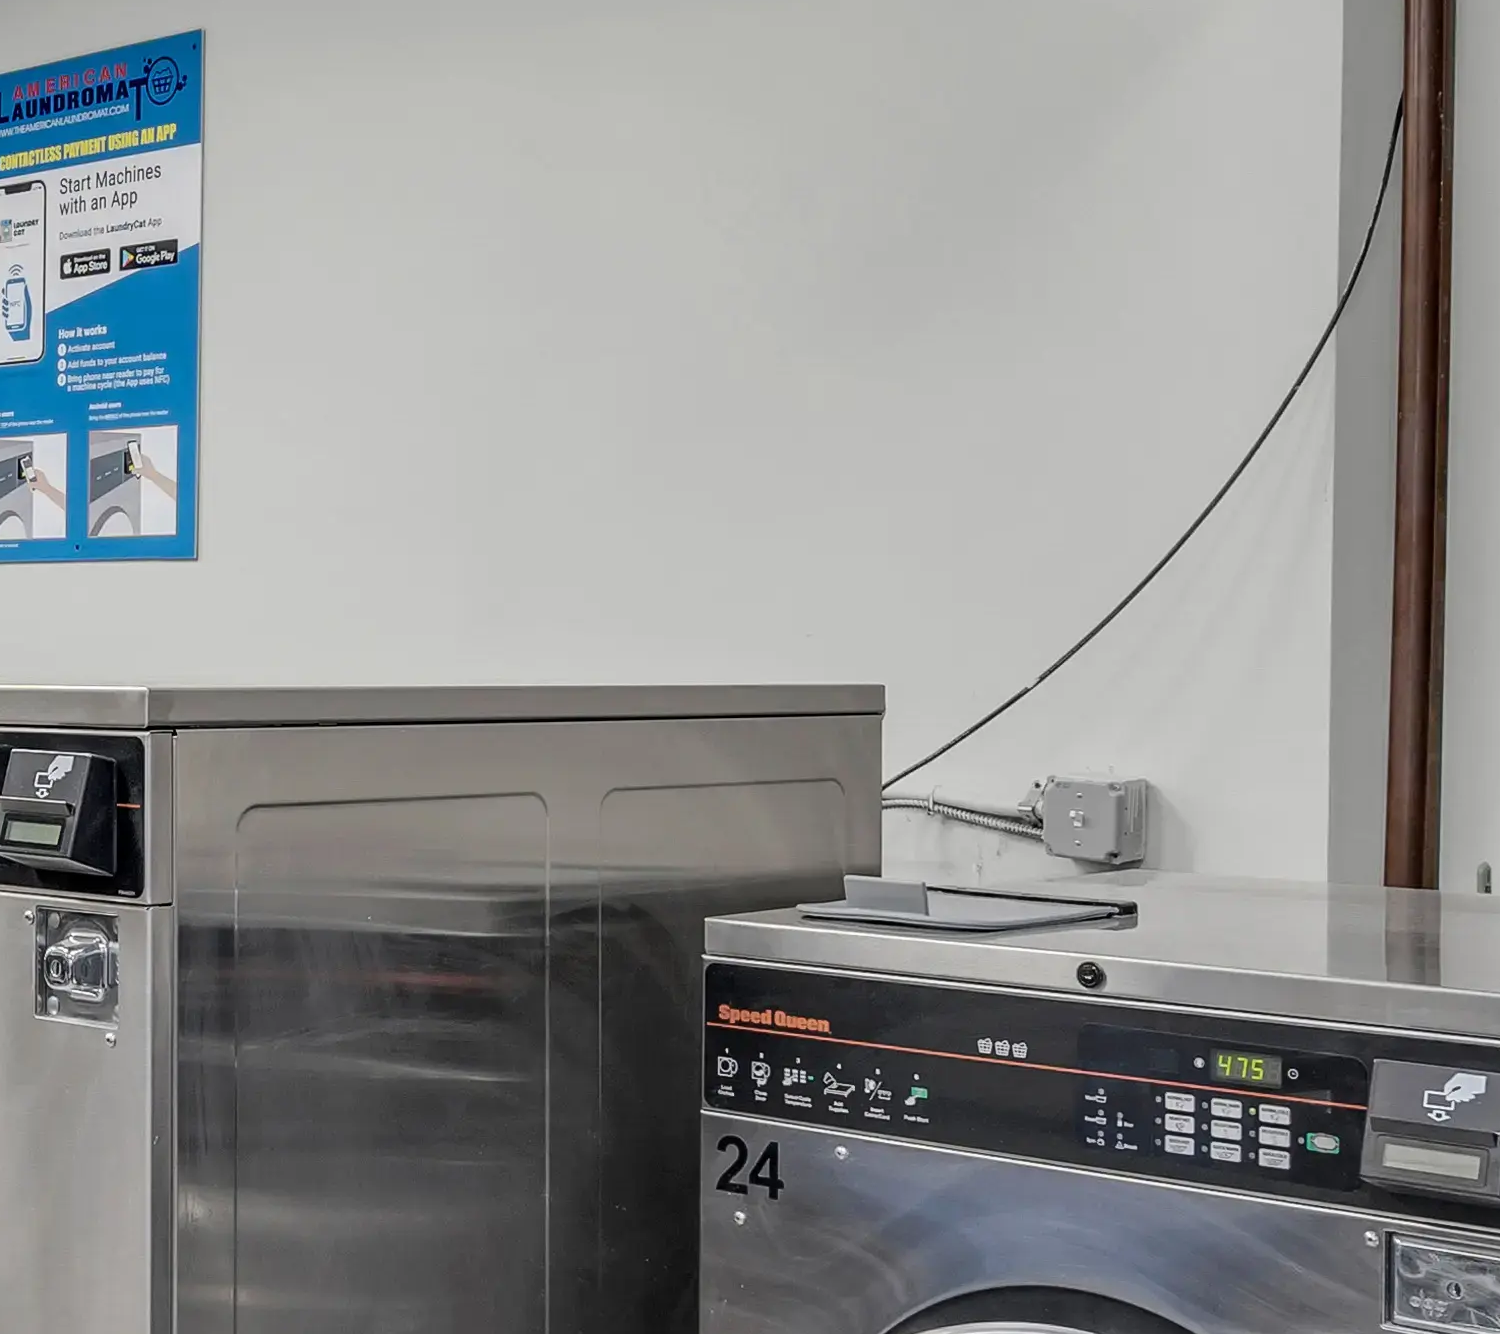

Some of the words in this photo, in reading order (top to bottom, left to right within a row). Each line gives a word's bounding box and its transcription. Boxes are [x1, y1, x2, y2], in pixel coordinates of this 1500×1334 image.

[13, 63, 127, 101] AMERICAN
[0, 146, 61, 172] CONTACTLESS
[63, 136, 107, 159] PAYMENT
[108, 131, 139, 151] USING
[141, 128, 155, 145] AN
[156, 123, 177, 142] APP
[60, 175, 91, 194] Start
[95, 165, 162, 188] Machines
[59, 195, 86, 216] with
[91, 195, 106, 211] an
[111, 190, 138, 210] App
[59, 228, 92, 241] Download
[106, 220, 146, 233] LaundryCat
[148, 217, 162, 227] App
[73, 262, 87, 274] App
[88, 260, 108, 271] Store
[136, 252, 160, 265] Google
[160, 250, 175, 261] Play
[58, 329, 75, 339] How
[76, 327, 83, 337] it
[84, 324, 107, 336] works
[718, 1003, 772, 1027] Speed
[774, 1009, 831, 1034] Queen
[1217, 1054, 1264, 1080] 475
[715, 1135, 785, 1201] 24
